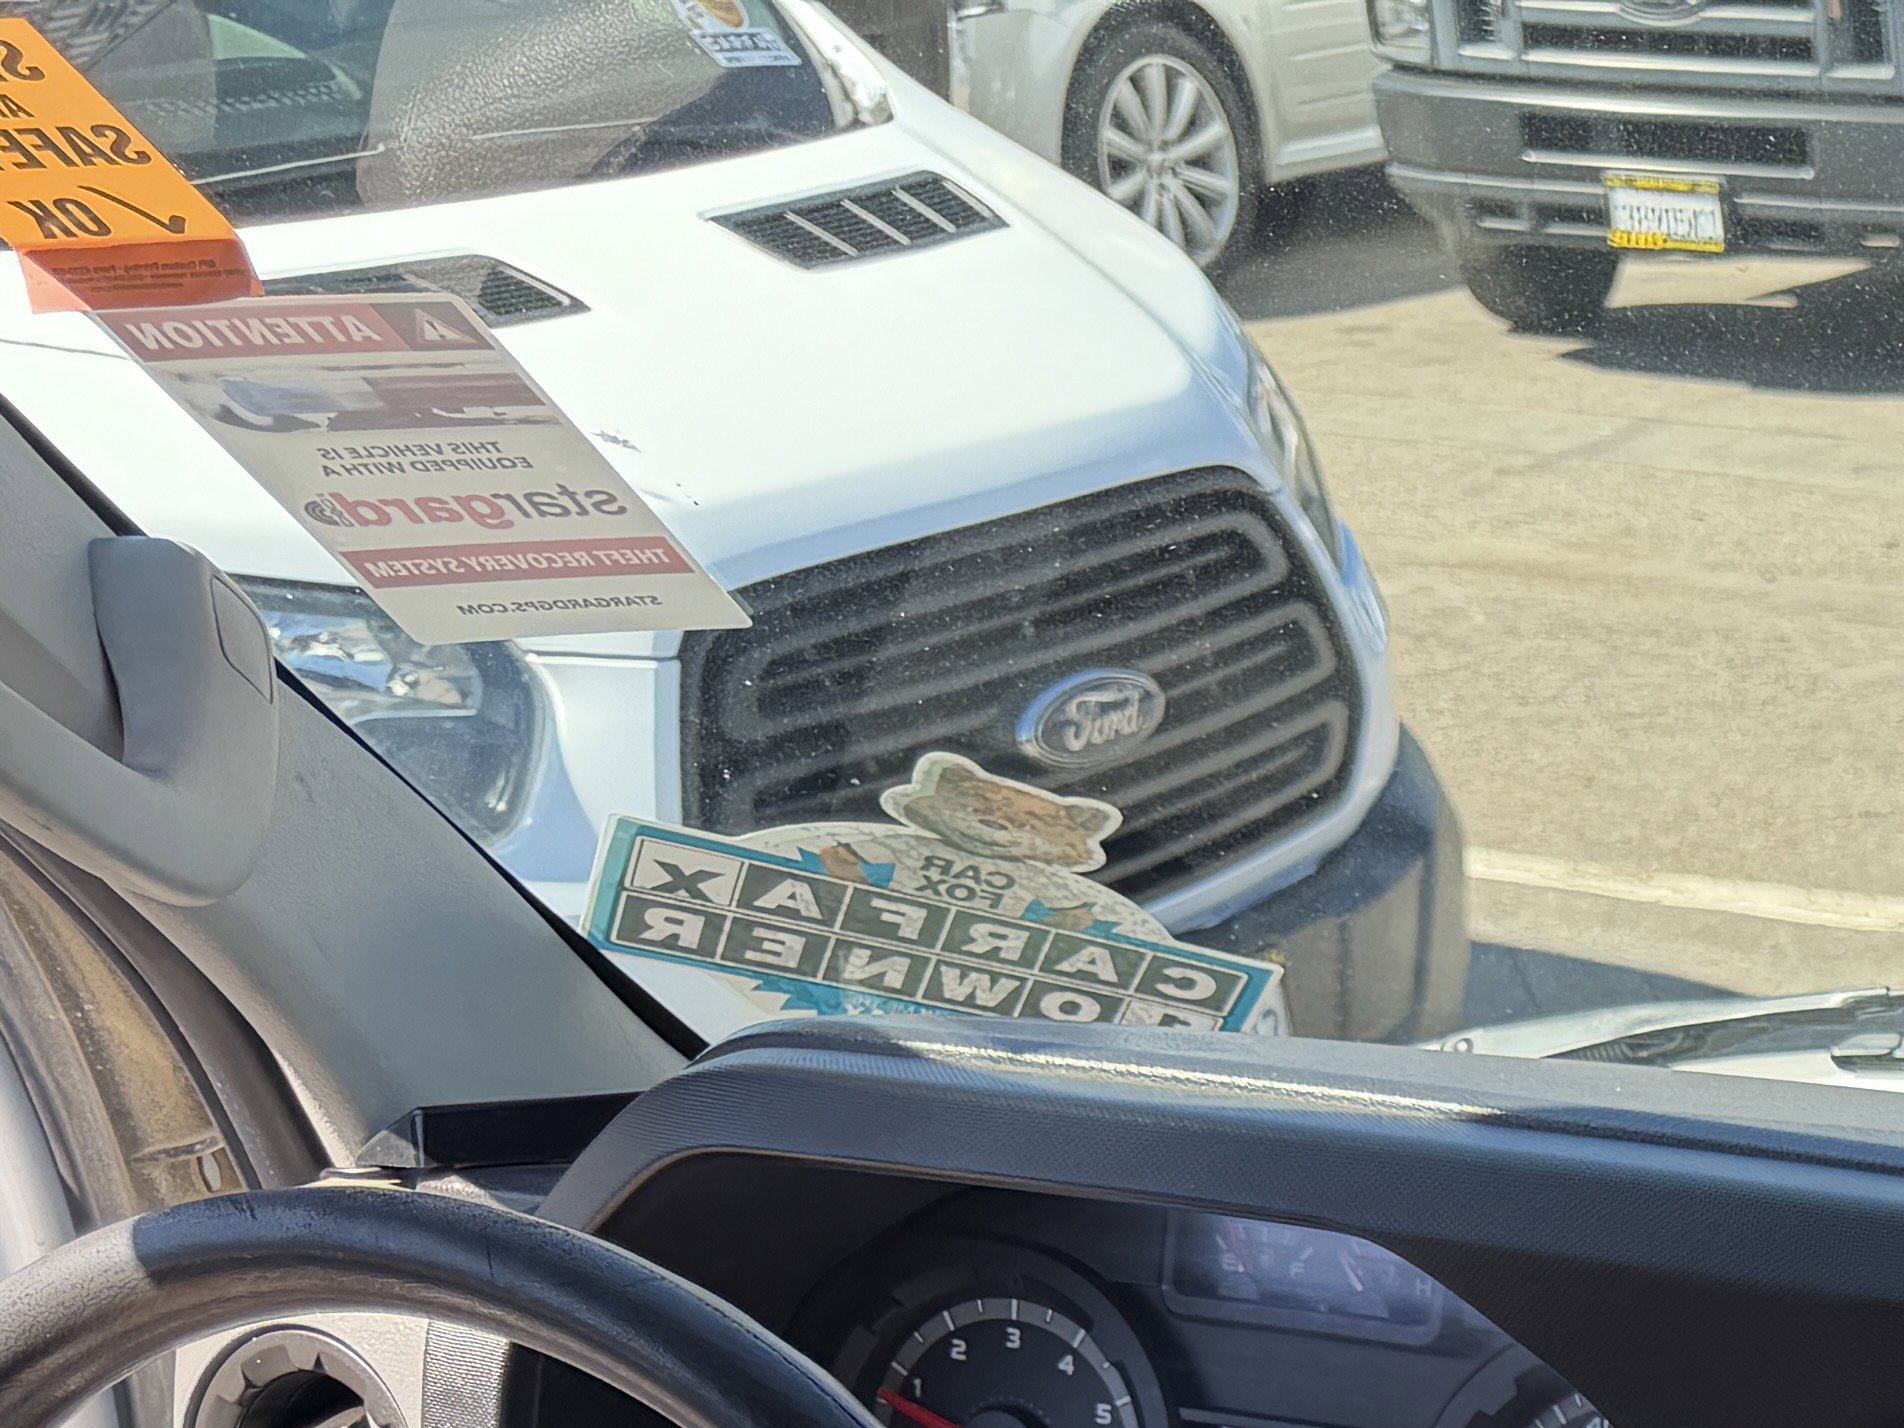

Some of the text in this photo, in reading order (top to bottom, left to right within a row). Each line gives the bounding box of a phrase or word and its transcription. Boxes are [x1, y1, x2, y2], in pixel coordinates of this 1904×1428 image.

[1063, 693, 1146, 752] Ford
[1416, 1278, 1432, 1297] H
[1005, 1326, 1021, 1349] 3
[950, 1338, 967, 1361] 2
[1058, 1355, 1075, 1376] 4
[912, 1378, 923, 1398] 1
[1095, 1403, 1112, 1425] 5
